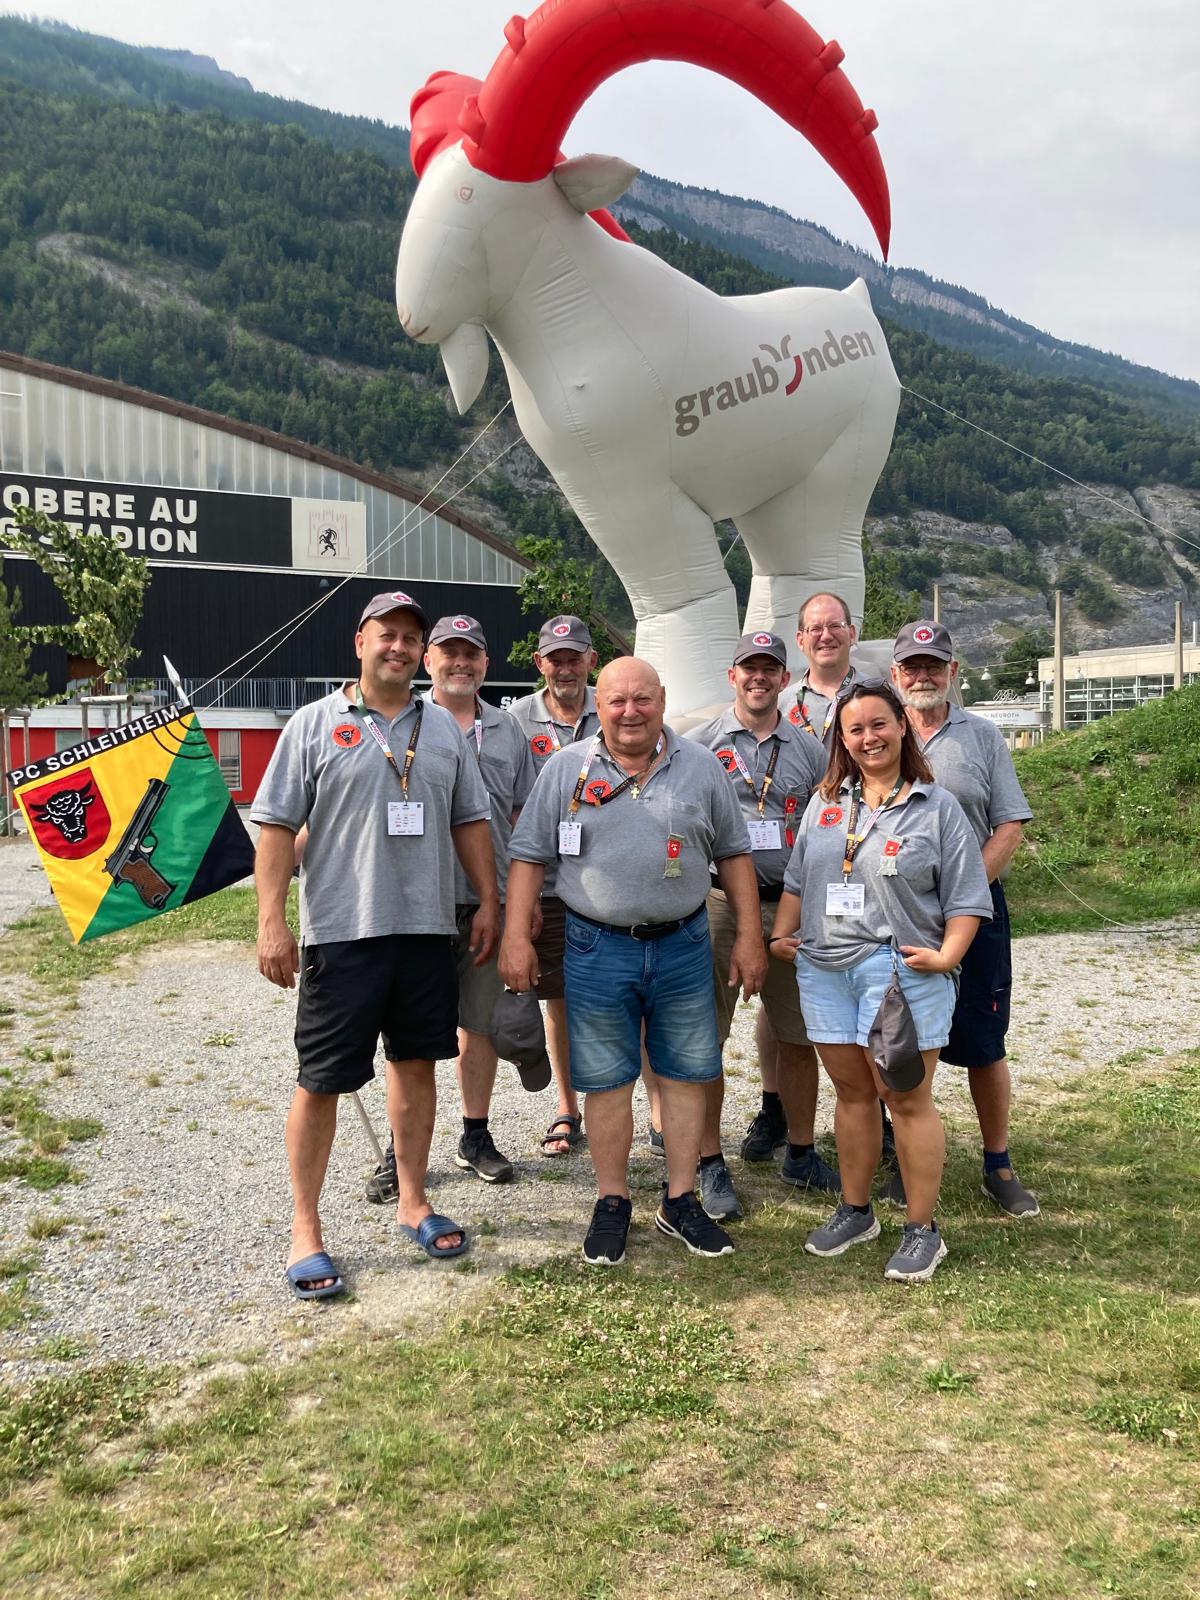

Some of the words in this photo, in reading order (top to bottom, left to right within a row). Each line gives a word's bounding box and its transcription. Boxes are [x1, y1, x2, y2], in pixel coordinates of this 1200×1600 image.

[3, 485, 135, 520] OBERE
[150, 497, 198, 524] AU
[10, 765, 41, 786] PC
[46, 705, 180, 771] SCHLEITHEIM
